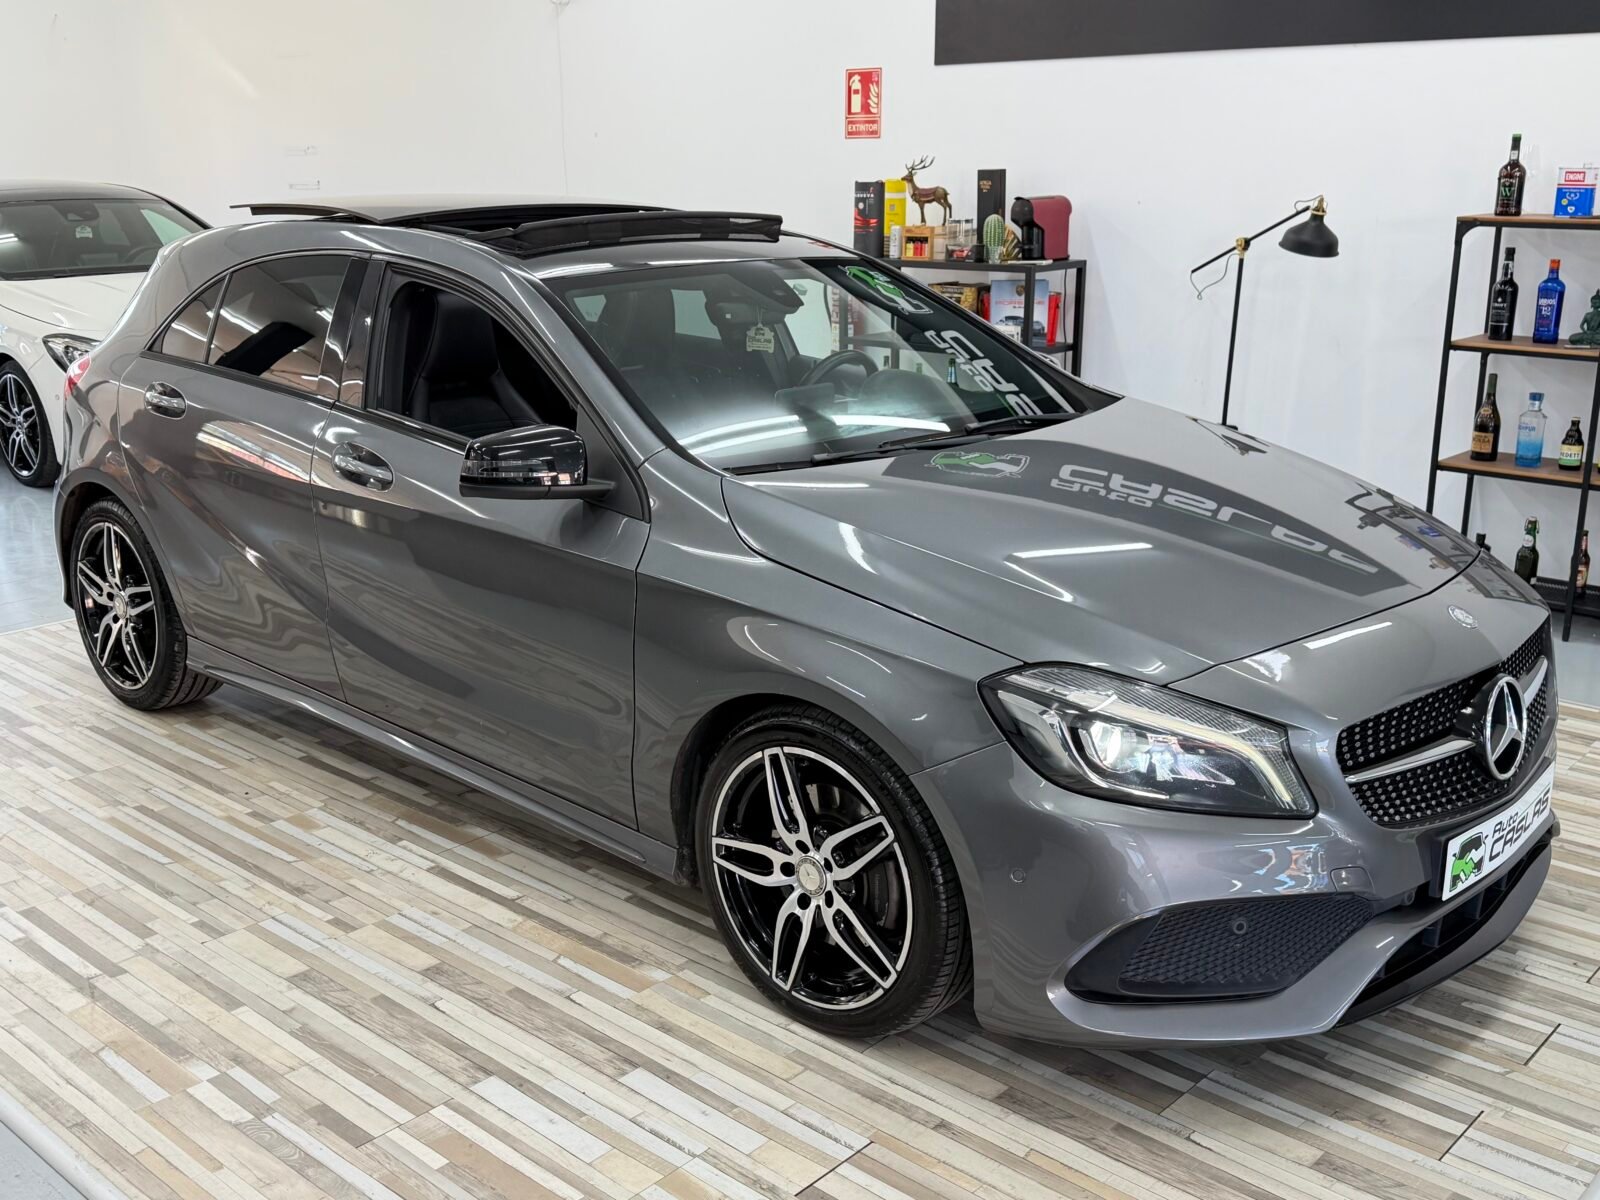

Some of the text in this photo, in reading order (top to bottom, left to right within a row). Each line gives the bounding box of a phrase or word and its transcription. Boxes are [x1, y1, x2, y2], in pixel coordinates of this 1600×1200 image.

[848, 123, 878, 132] EXTINTOR
[1488, 786, 1551, 862] CASLAS
[1491, 811, 1520, 839] Auto
